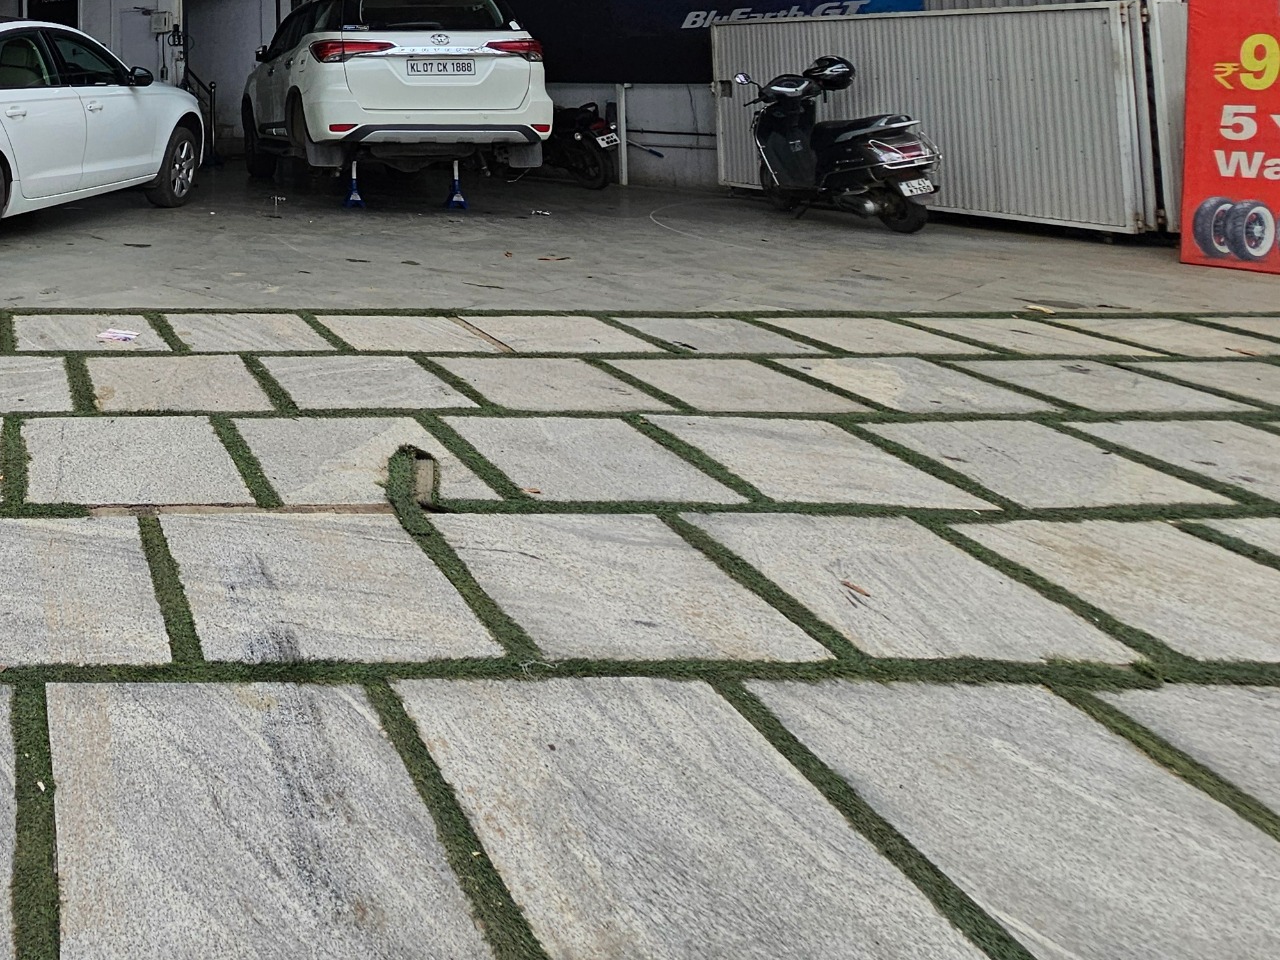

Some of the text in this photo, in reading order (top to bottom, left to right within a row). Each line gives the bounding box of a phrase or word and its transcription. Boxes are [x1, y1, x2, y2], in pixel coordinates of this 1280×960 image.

[410, 62, 472, 73] KL 07 CK 1888
[1219, 104, 1258, 140] 5
